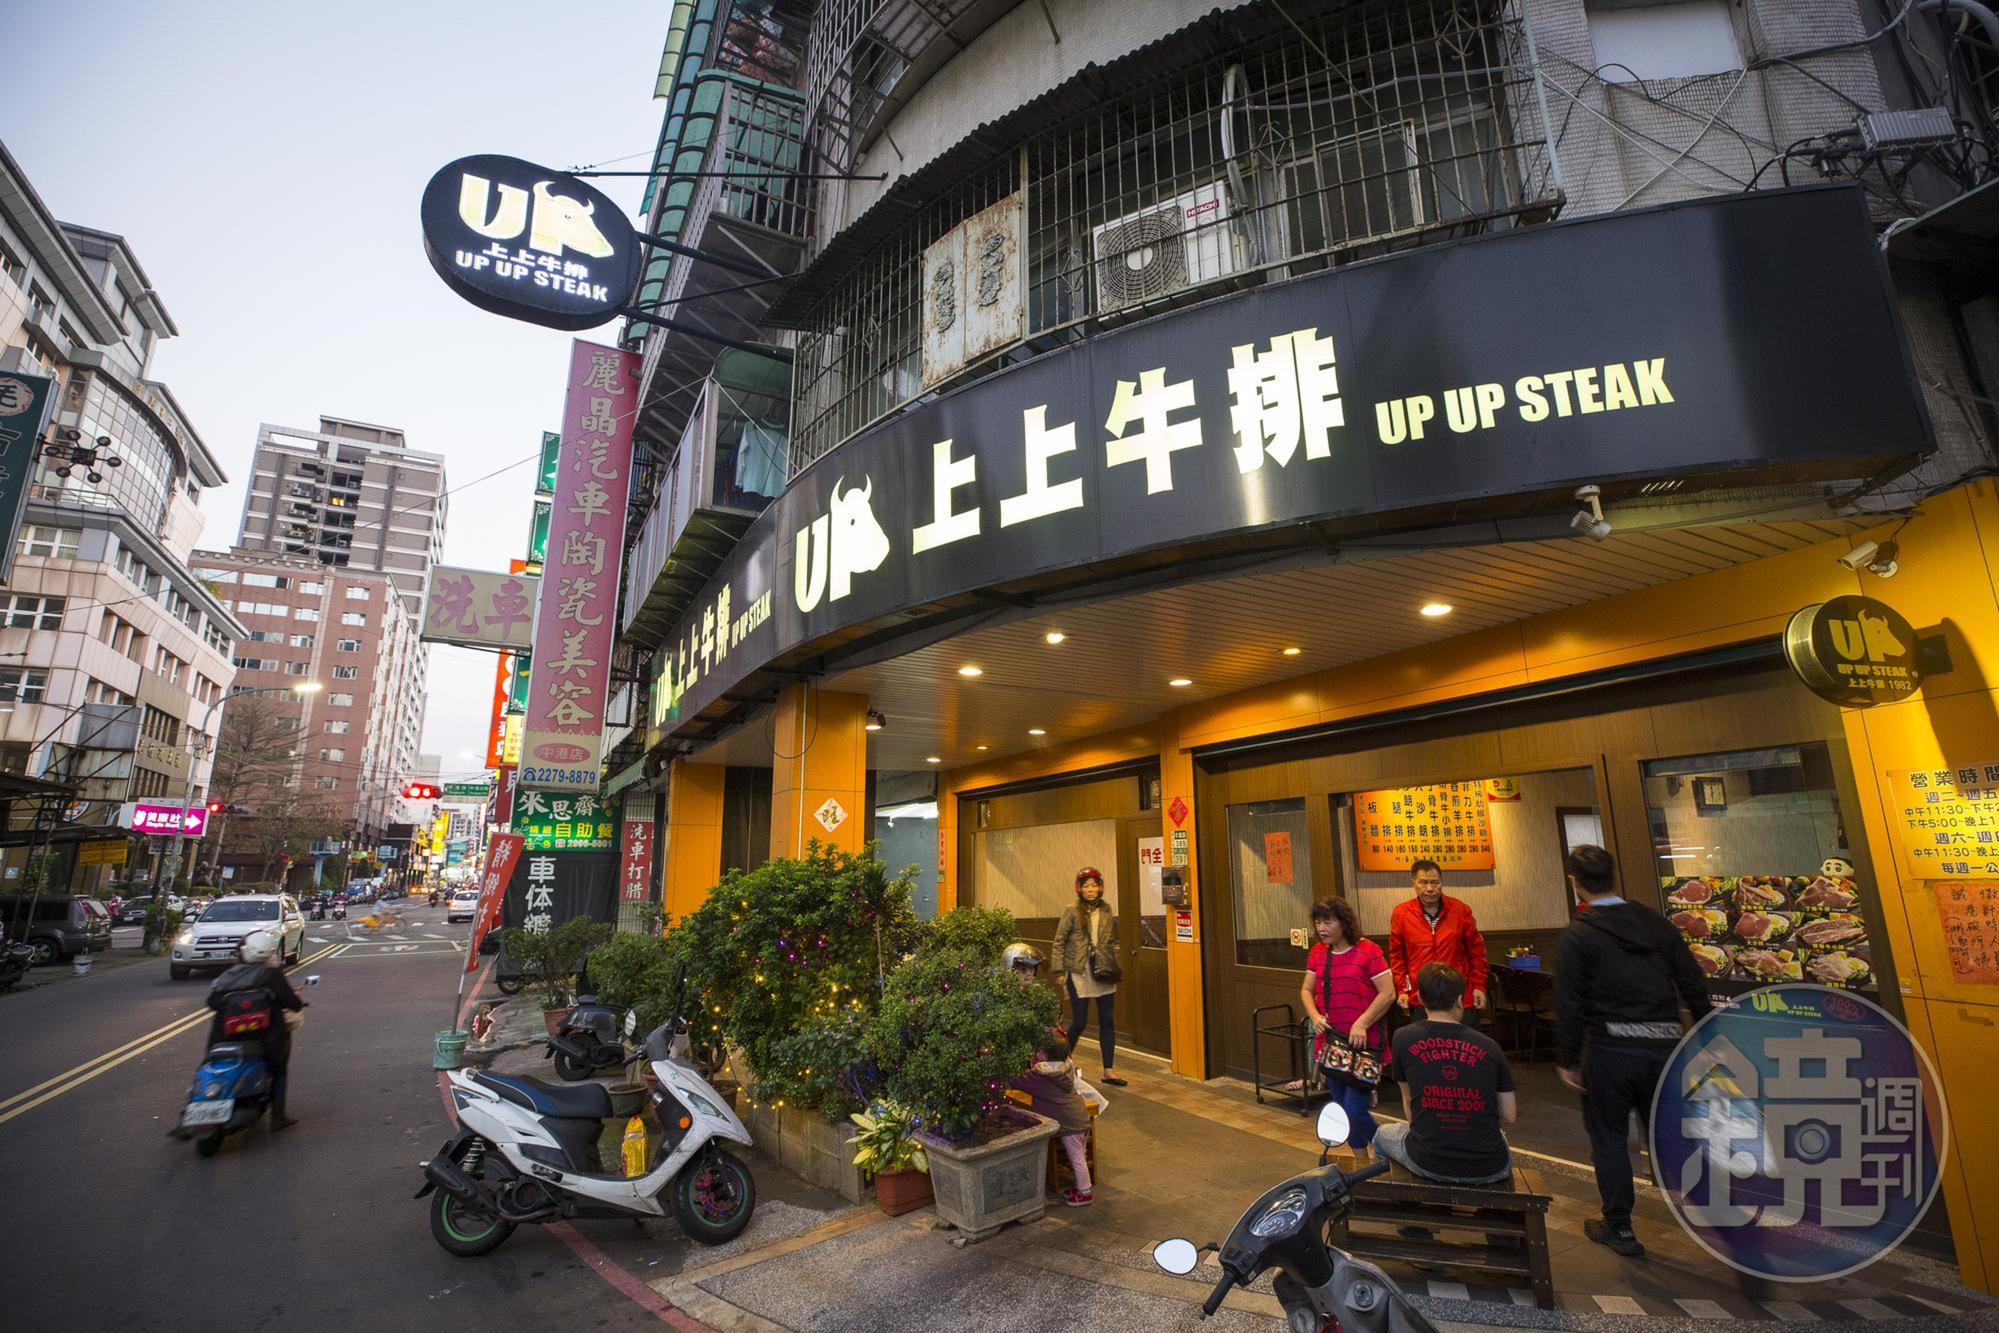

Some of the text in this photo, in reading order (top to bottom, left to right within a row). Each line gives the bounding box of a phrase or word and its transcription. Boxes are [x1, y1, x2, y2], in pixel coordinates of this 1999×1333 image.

[482, 242, 588, 280] 上上牛排
[456, 250, 608, 302] UP UP STEAK
[1375, 357, 1675, 445] UP UP STEAK
[912, 327, 1345, 555] 上上牛排
[430, 575, 531, 640] 洗車
[1837, 663, 1908, 678] UP UP STEAK
[1889, 680, 1912, 690] 1982
[540, 743, 584, 761] 中港店
[537, 767, 596, 785] 2279-8879
[1910, 765, 1999, 788] 營業時間
[1420, 1048, 1477, 1067] FIGHTER
